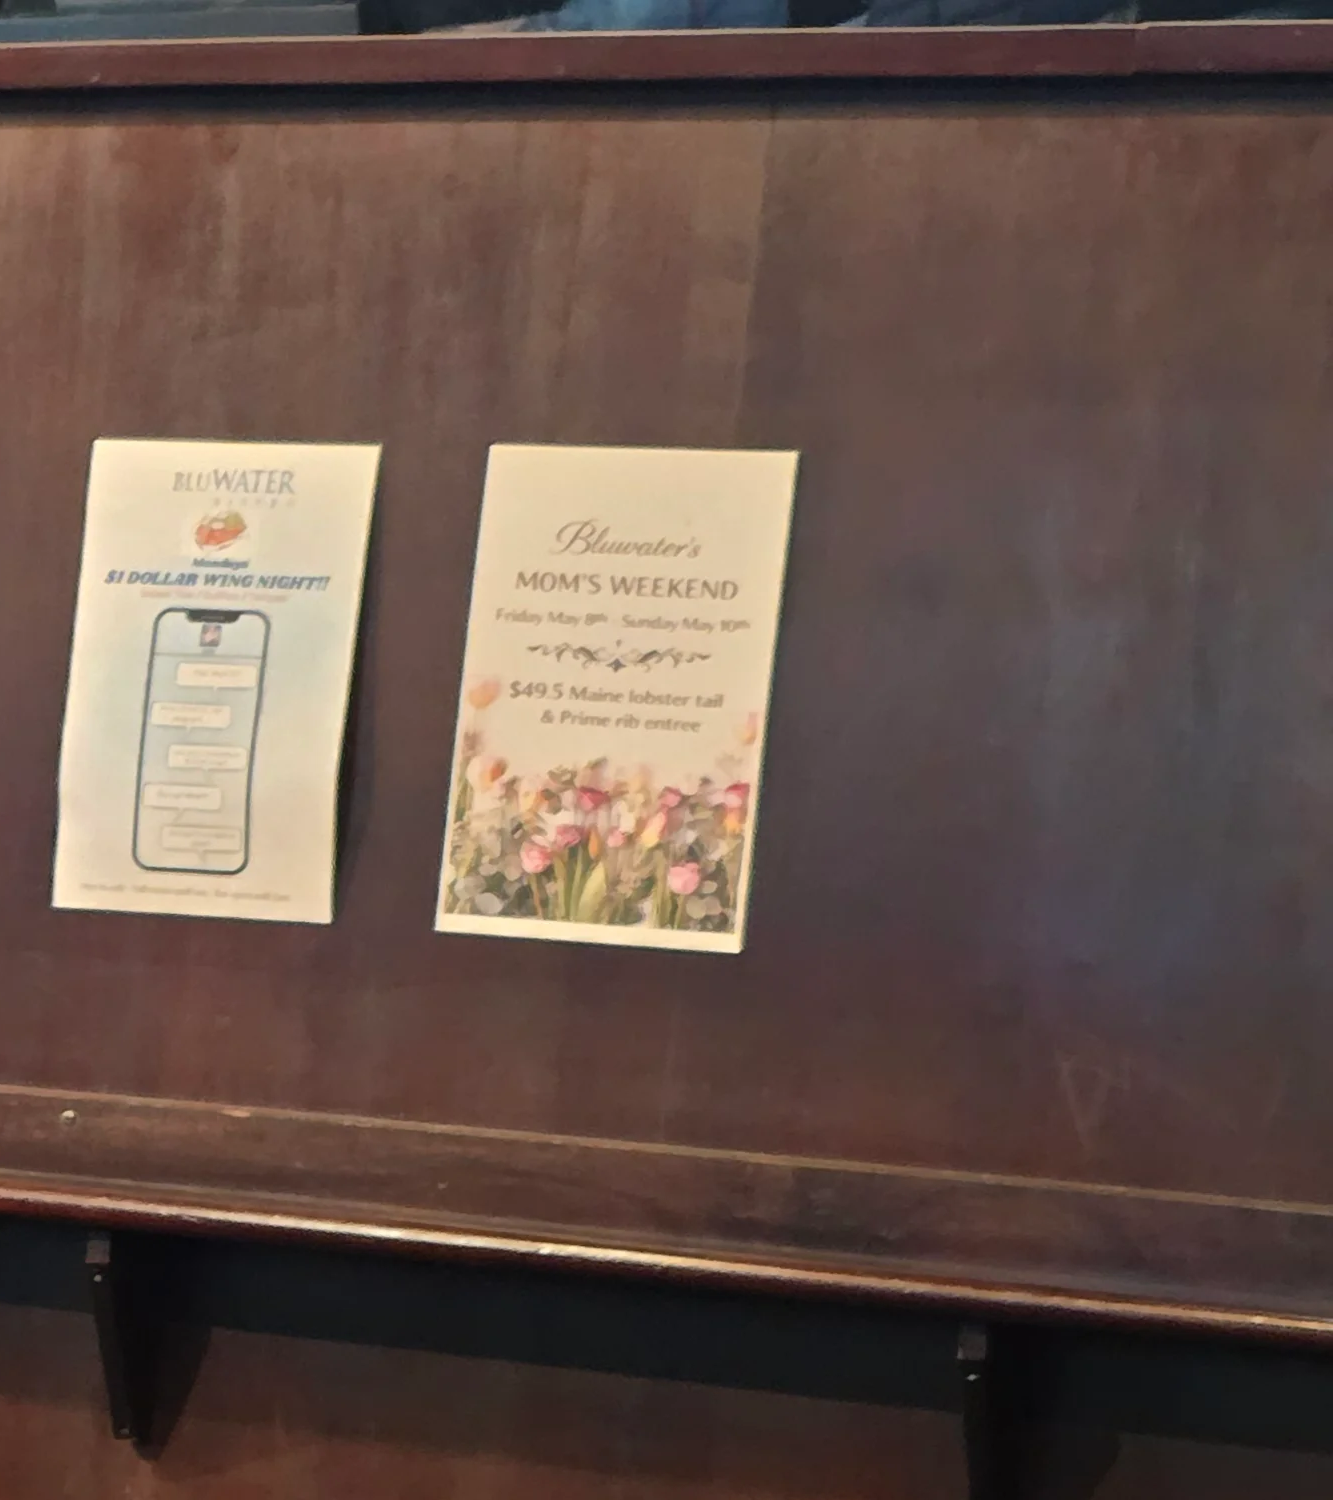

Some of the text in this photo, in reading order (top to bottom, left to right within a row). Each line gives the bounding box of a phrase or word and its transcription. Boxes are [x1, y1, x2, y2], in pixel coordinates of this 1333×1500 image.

[172, 468, 295, 495] BLUWATER
[549, 518, 702, 559] Bluwater's
[104, 569, 126, 584] $1
[127, 570, 200, 587] DOLLAR
[203, 573, 254, 588] WING
[515, 571, 739, 600] MOM'S WEEKEND
[495, 608, 543, 626] Friday
[547, 611, 581, 627] May
[621, 613, 679, 633] Sunday
[682, 617, 716, 634] May
[509, 680, 724, 708] $49.5 Maine lobster tail
[540, 709, 701, 733] & Prime rib entree
